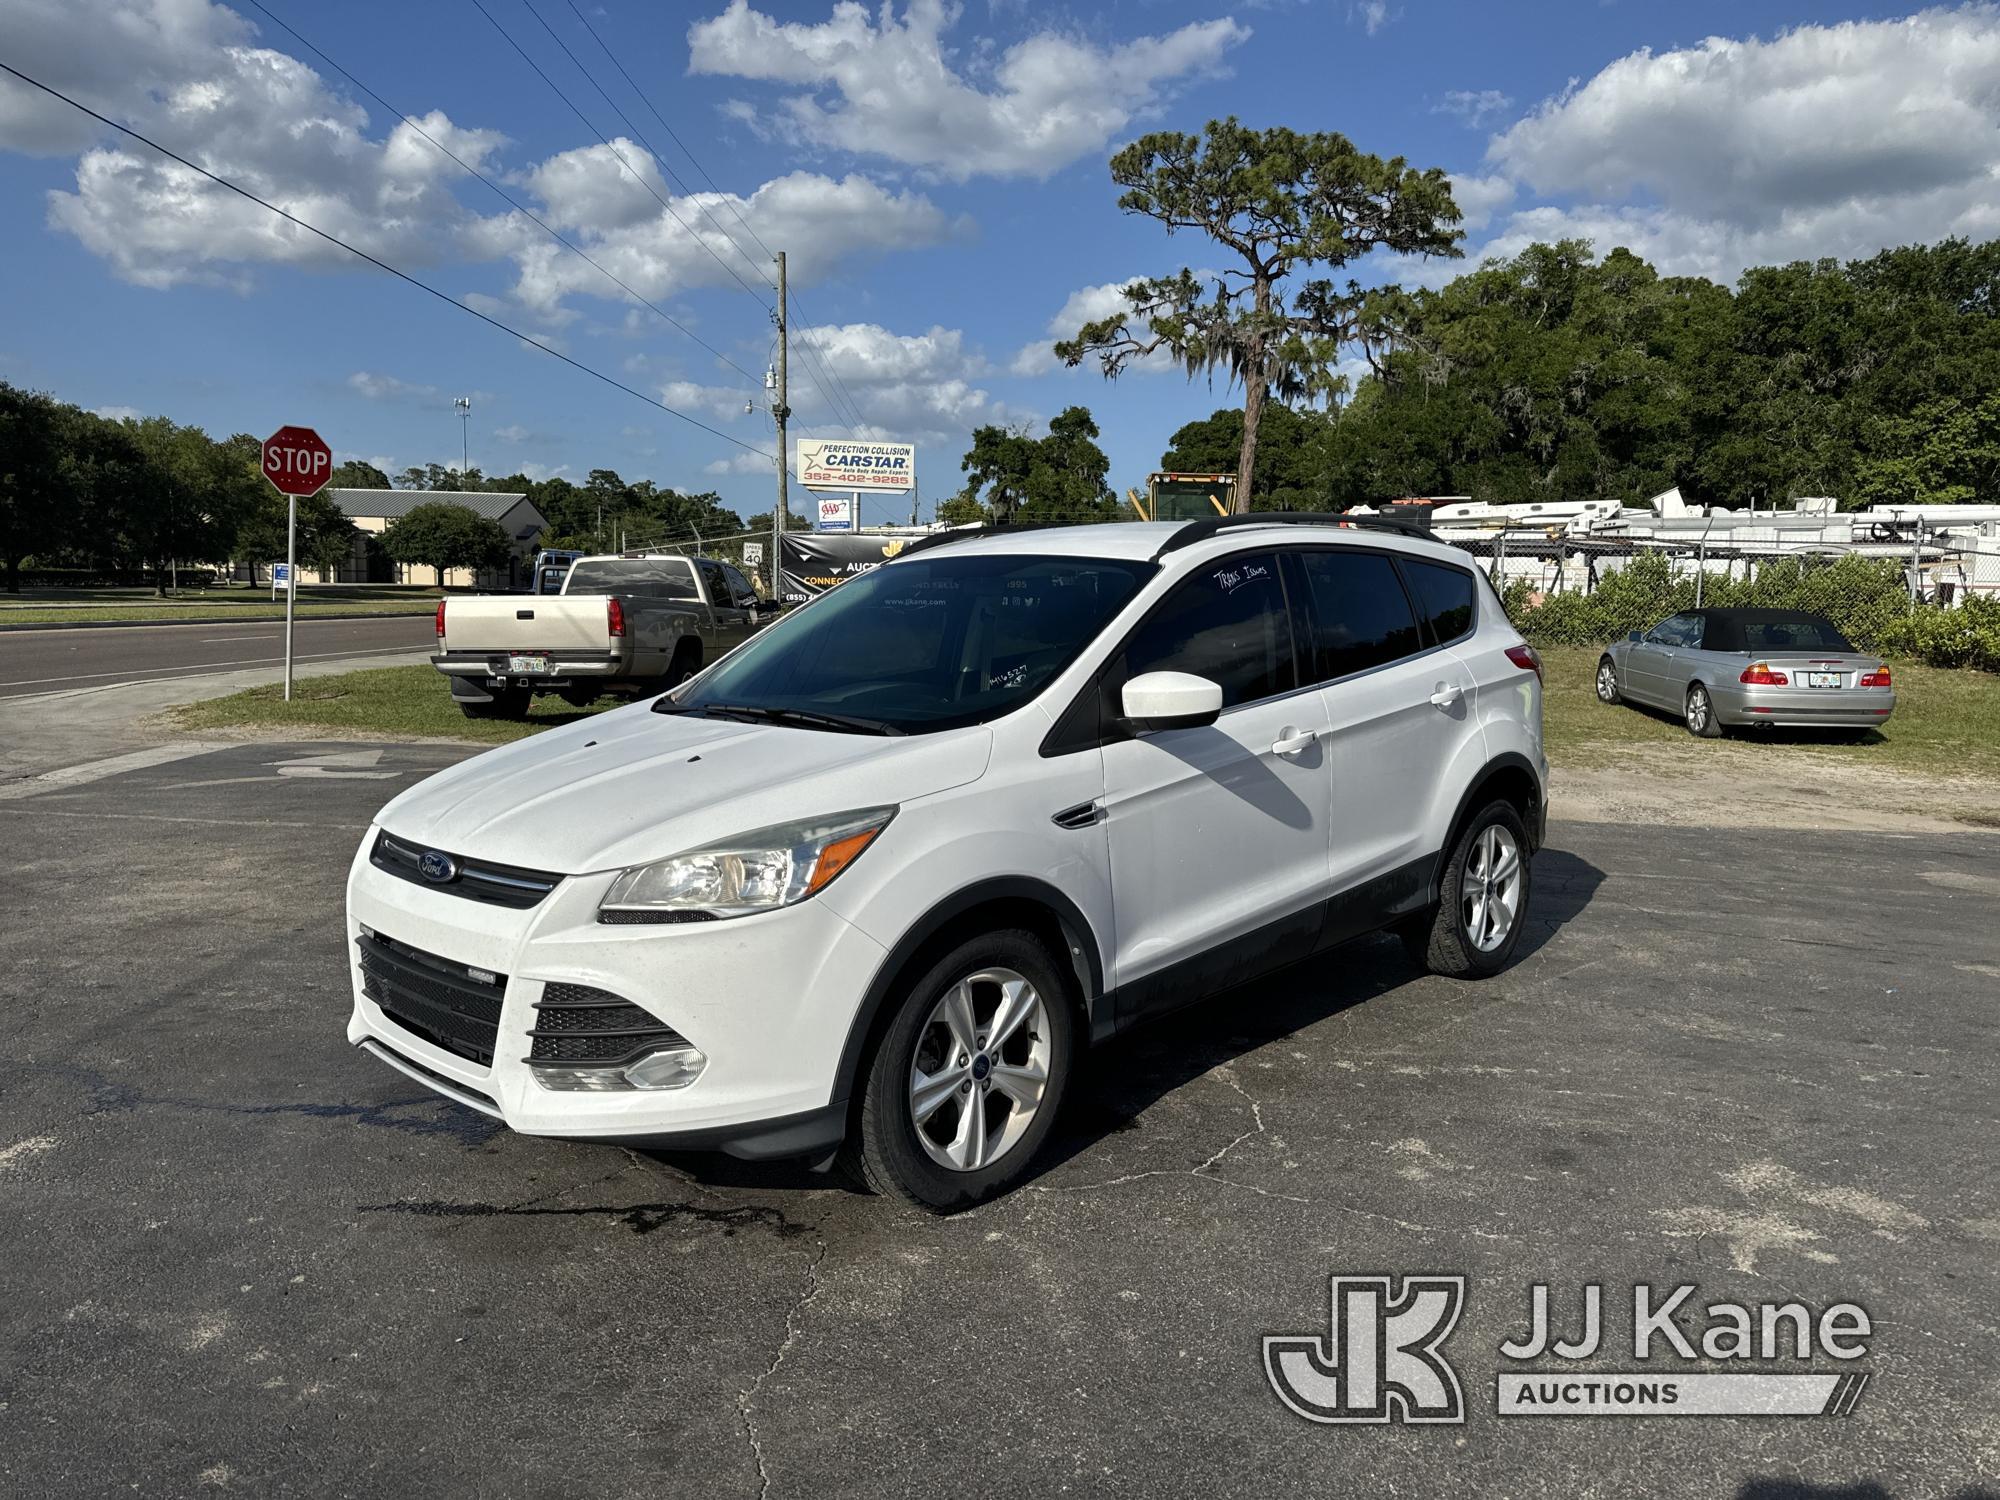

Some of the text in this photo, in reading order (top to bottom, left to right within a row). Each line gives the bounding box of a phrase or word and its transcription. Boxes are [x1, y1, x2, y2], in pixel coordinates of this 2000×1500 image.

[823, 444, 911, 456] PERFECTION COLLISION
[267, 446, 328, 476] STOP
[825, 454, 906, 469] CARSTAR
[804, 472, 909, 484] 352-402-9285
[745, 555, 761, 564] 40
[1213, 570, 1240, 589] TRANS
[786, 593, 807, 602] (855)
